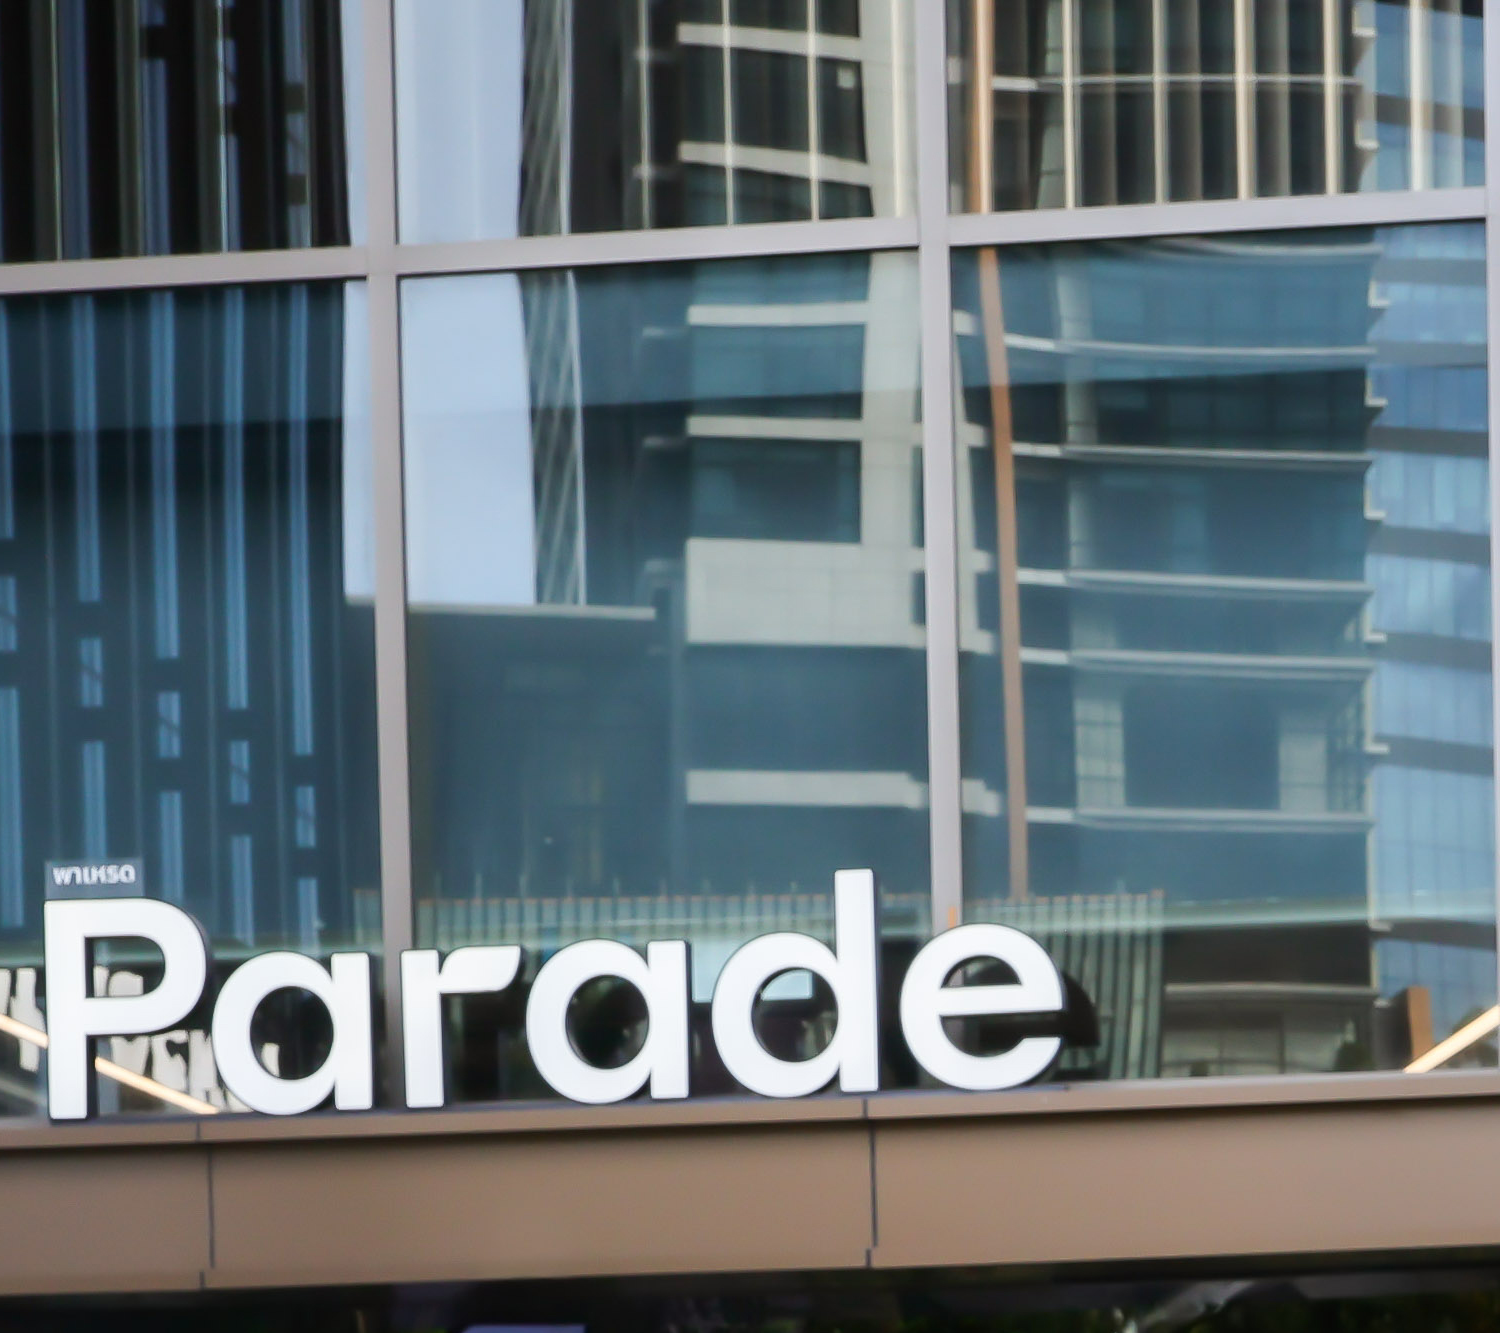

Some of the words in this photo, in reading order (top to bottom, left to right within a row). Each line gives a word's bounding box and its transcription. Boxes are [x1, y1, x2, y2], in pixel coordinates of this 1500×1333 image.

[51, 863, 136, 887] พาเหรด
[44, 868, 1066, 1121] Parade
